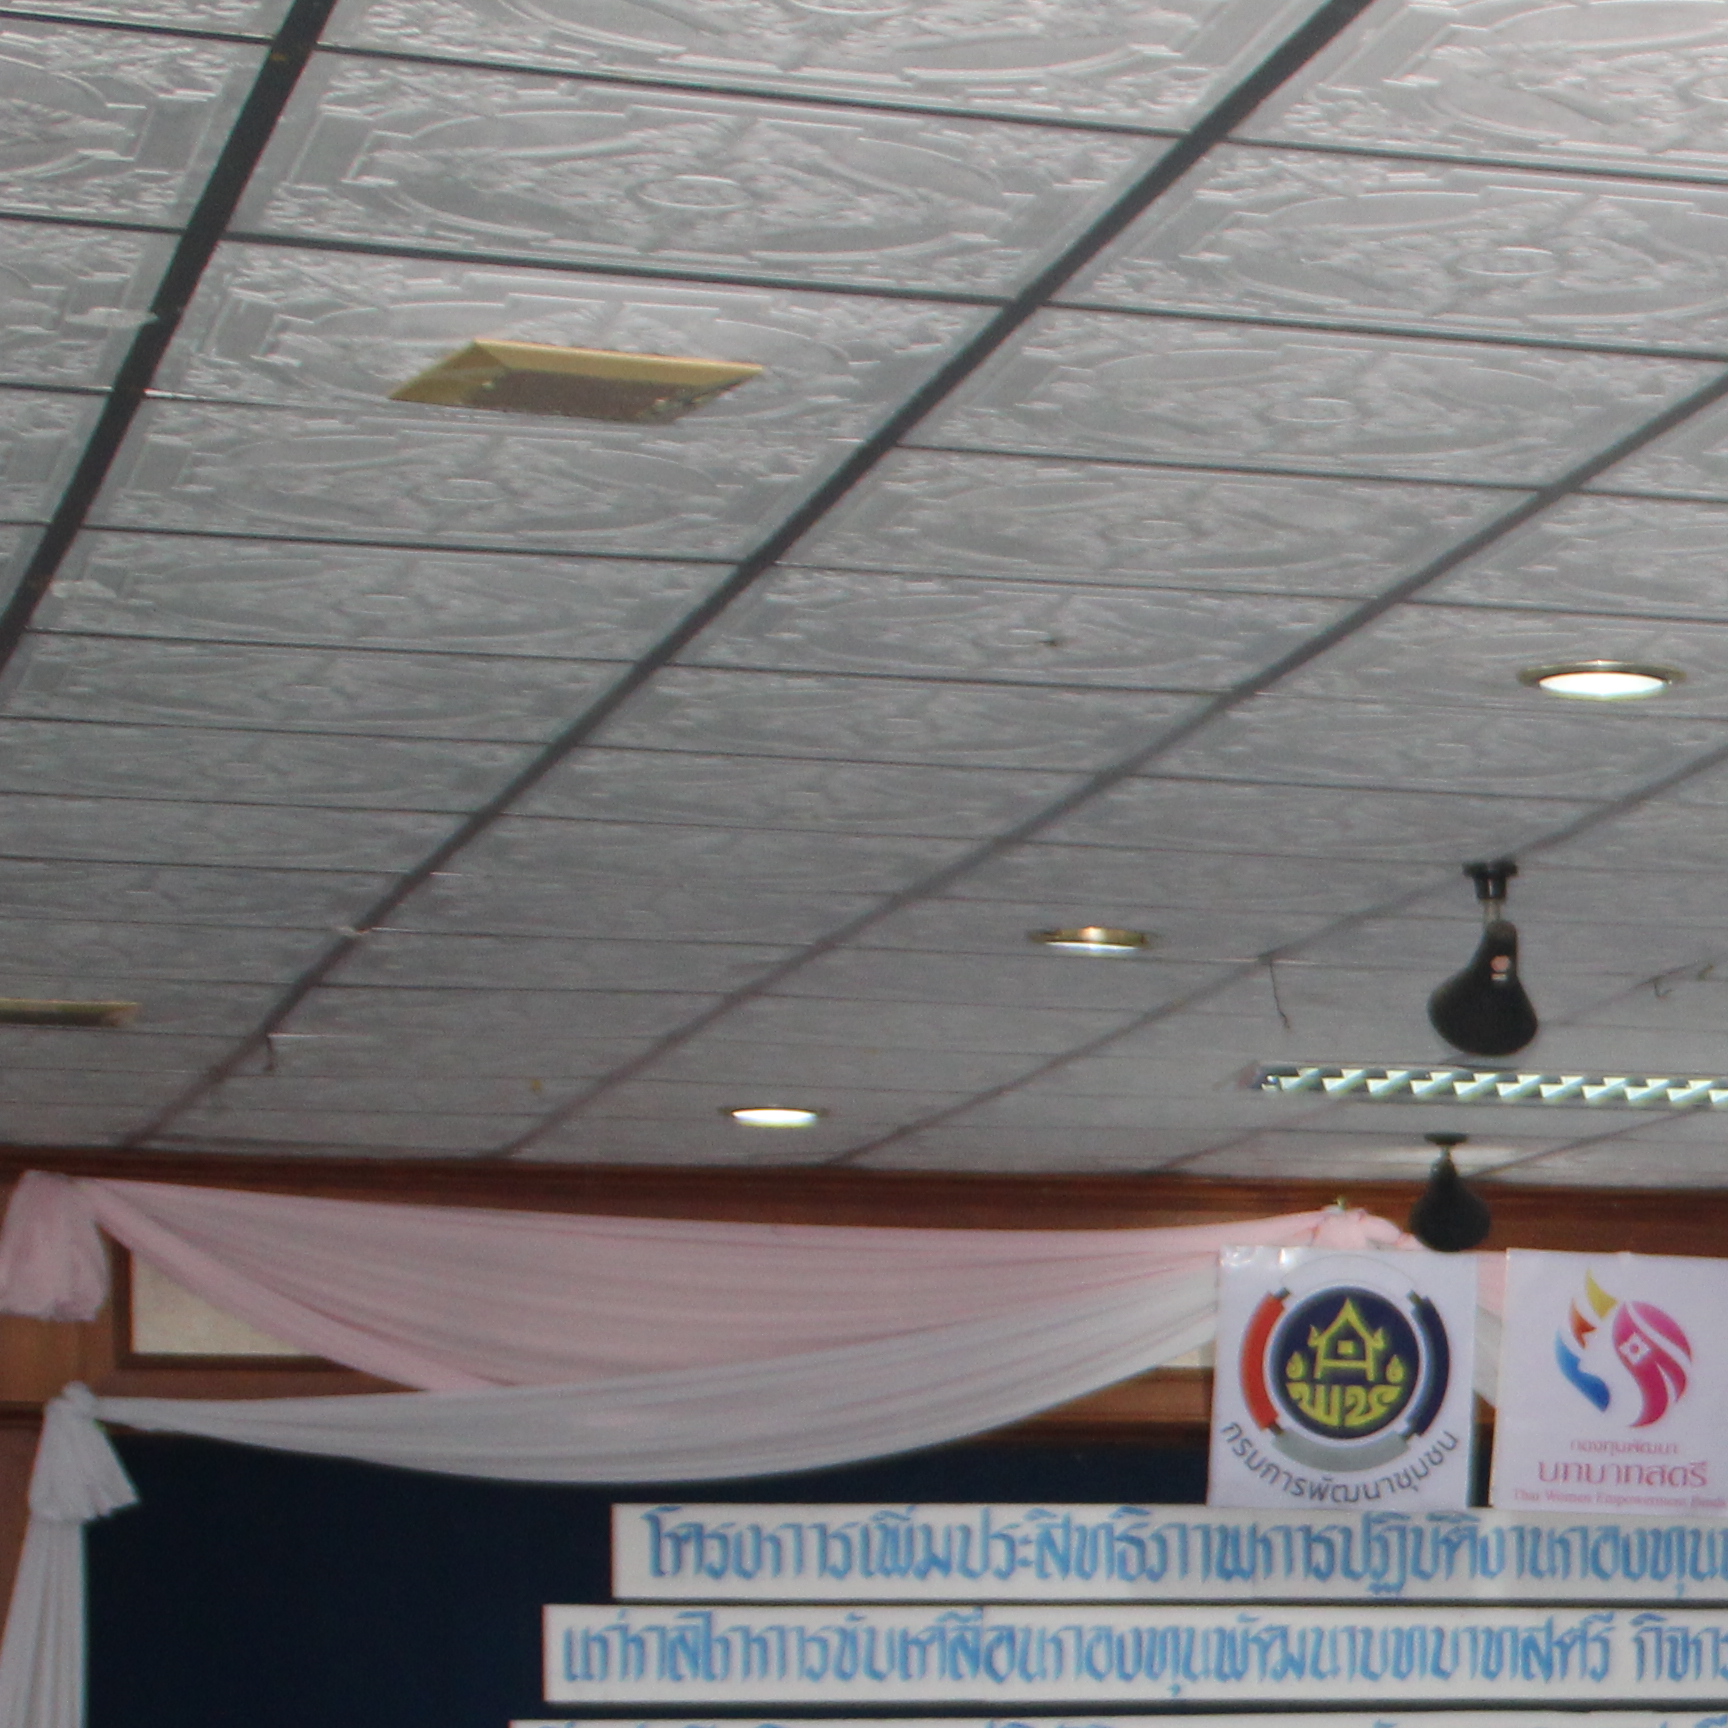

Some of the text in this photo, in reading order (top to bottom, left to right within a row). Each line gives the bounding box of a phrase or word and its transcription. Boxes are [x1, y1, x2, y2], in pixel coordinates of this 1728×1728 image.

[1220, 1419, 1459, 1504] กรมการพัฒนาชุมชน
[1537, 1460, 1709, 1488] บทบาทสตรี
